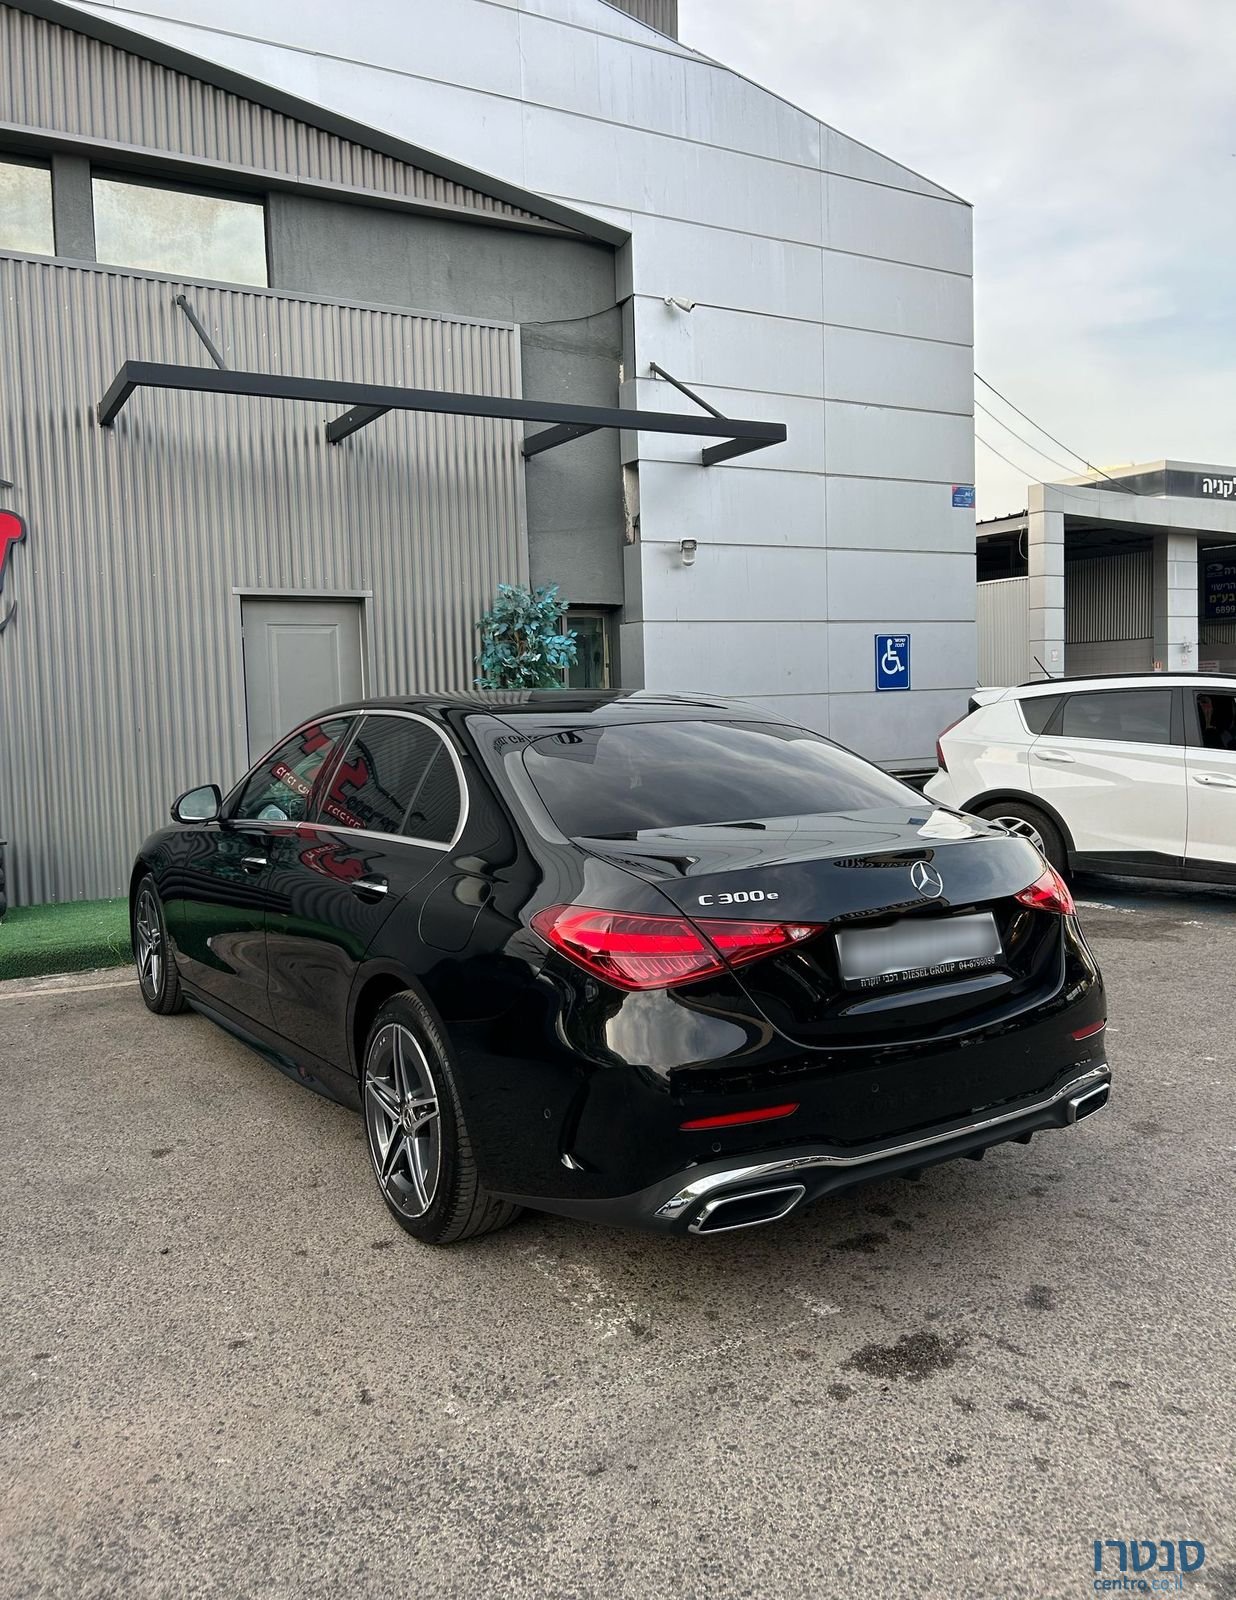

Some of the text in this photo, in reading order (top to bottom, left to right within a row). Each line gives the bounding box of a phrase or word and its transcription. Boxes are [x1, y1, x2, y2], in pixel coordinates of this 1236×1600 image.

[698, 890, 779, 906] C 300e
[902, 967, 929, 981] DIESEL
[930, 962, 955, 976] GROUP
